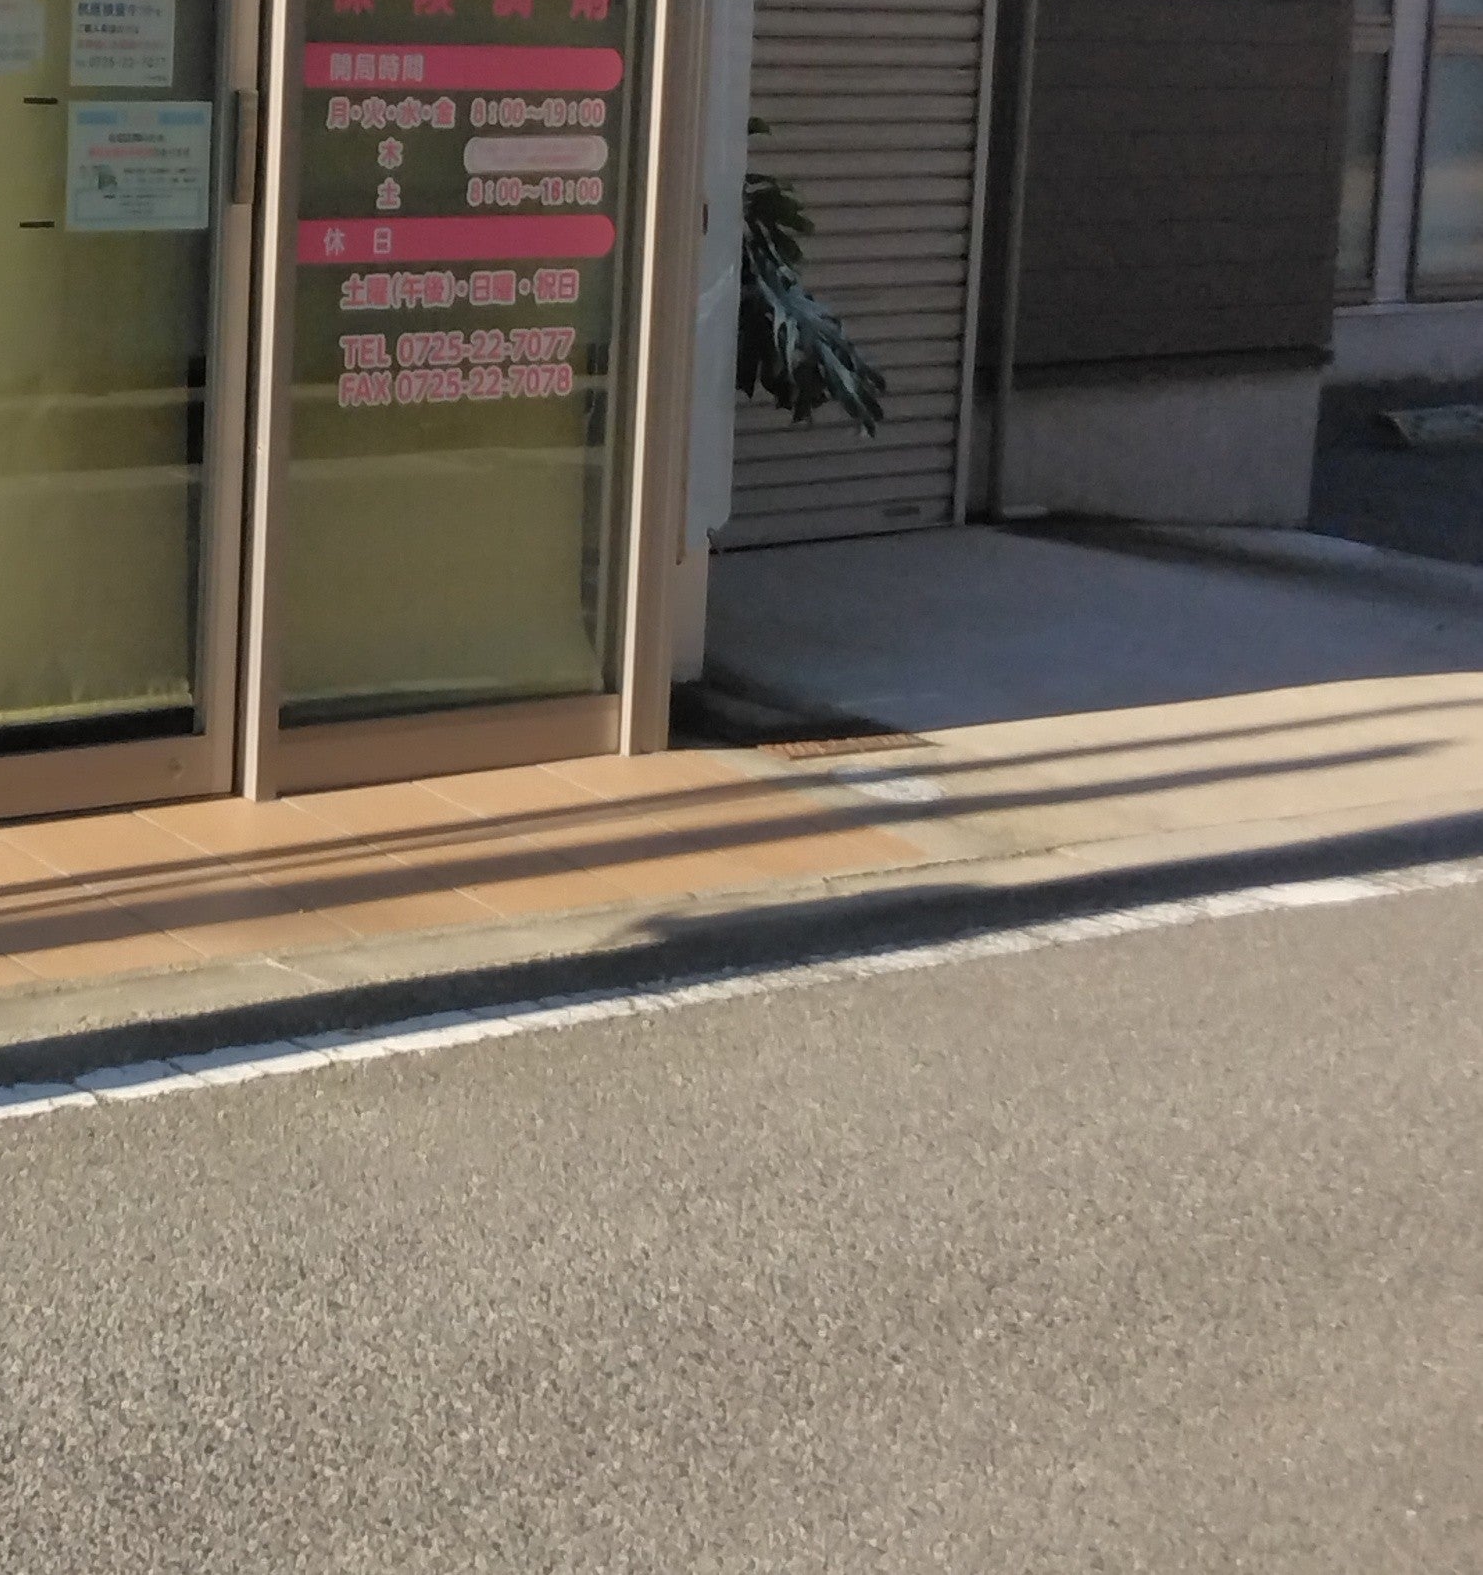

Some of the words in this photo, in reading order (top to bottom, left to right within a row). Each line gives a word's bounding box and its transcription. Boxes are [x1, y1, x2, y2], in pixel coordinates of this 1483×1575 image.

[376, 136, 404, 170] 木
[375, 176, 402, 210] 土
[338, 333, 392, 370] TEL
[396, 326, 576, 368] 0725-22-7077
[338, 372, 392, 407] FAX
[395, 363, 574, 406] 0725-22-7078
